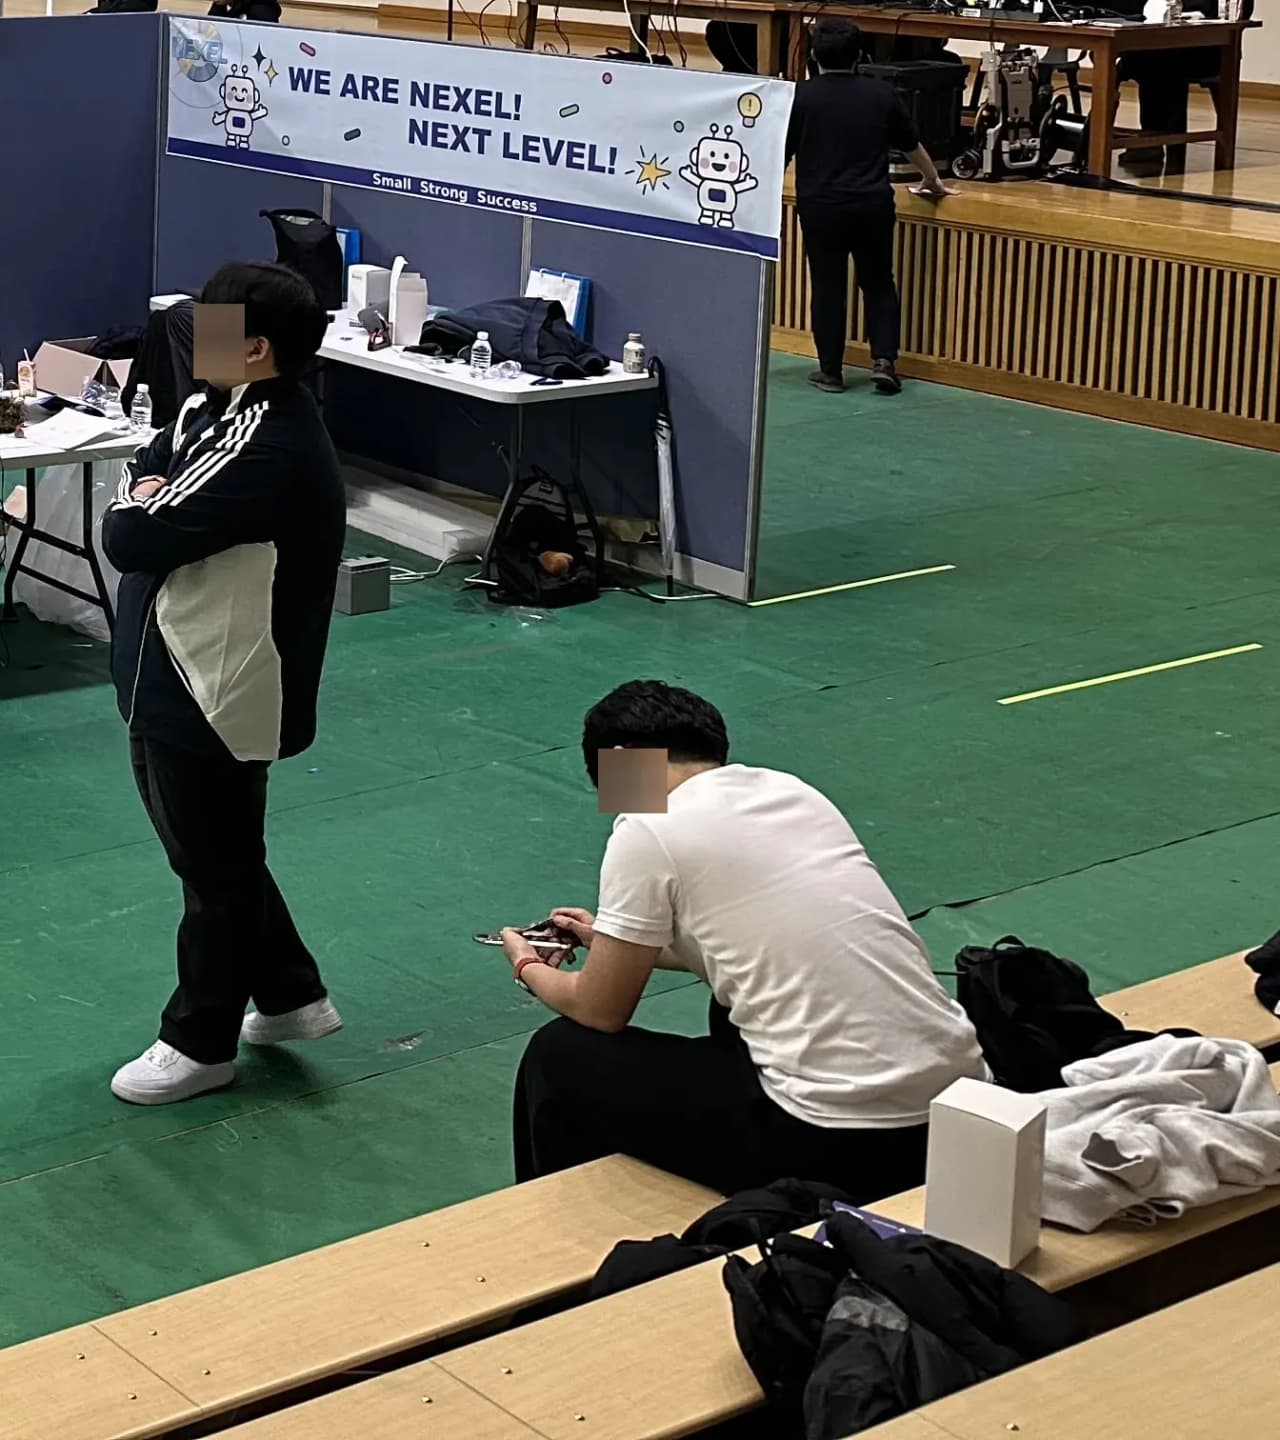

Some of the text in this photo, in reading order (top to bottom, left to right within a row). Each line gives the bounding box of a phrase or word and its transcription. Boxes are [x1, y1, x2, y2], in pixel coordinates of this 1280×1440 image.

[289, 66, 523, 122] WE ARE NEXEL!
[407, 117, 618, 175] NEXT LEVEL!
[372, 172, 538, 213] Small Strong Success
